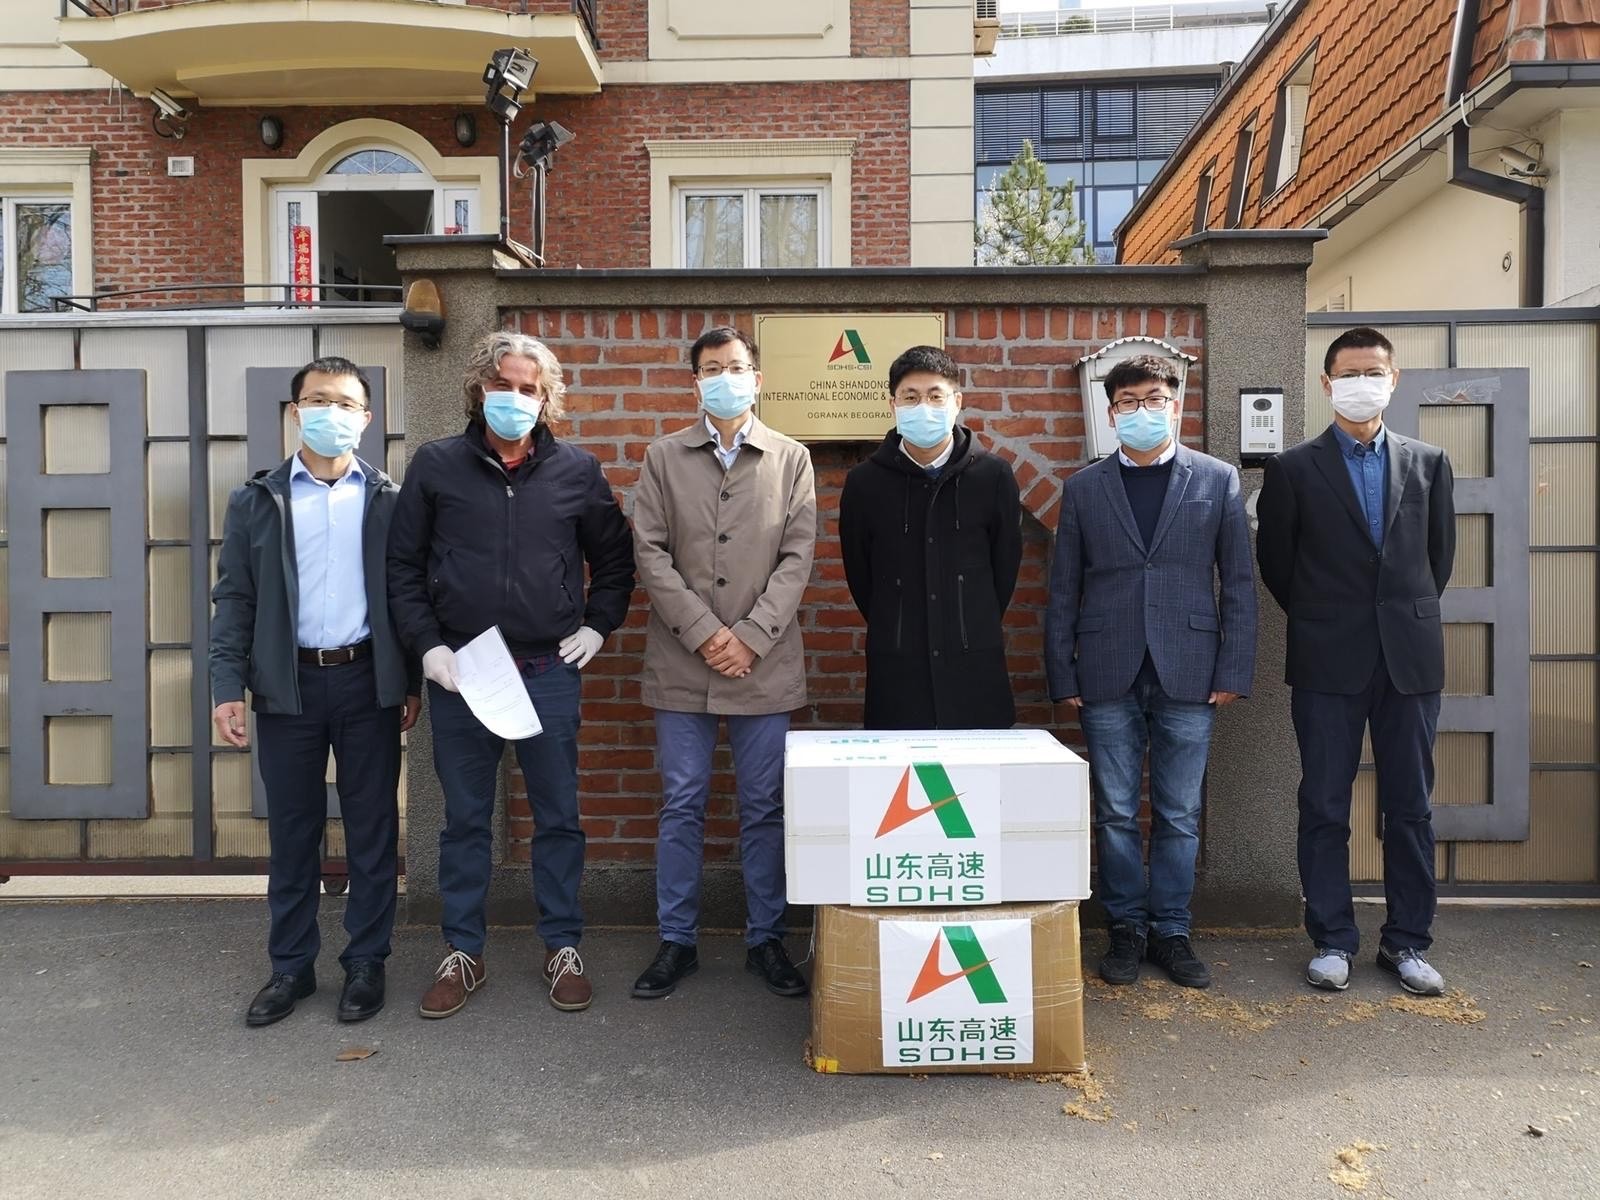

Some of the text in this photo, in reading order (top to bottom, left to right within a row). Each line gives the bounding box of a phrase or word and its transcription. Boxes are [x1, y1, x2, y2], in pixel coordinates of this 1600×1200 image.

[809, 380, 890, 390] CHINA SHANDONG
[762, 391, 887, 401] INTERNATIONAL ECONOMIC &
[807, 411, 892, 419] OGRANAK BEOGRAD
[866, 851, 985, 880] 山东高速
[866, 885, 985, 903] SDHS
[898, 1015, 1017, 1042] 山东高速
[899, 1045, 1016, 1063] SDHS
